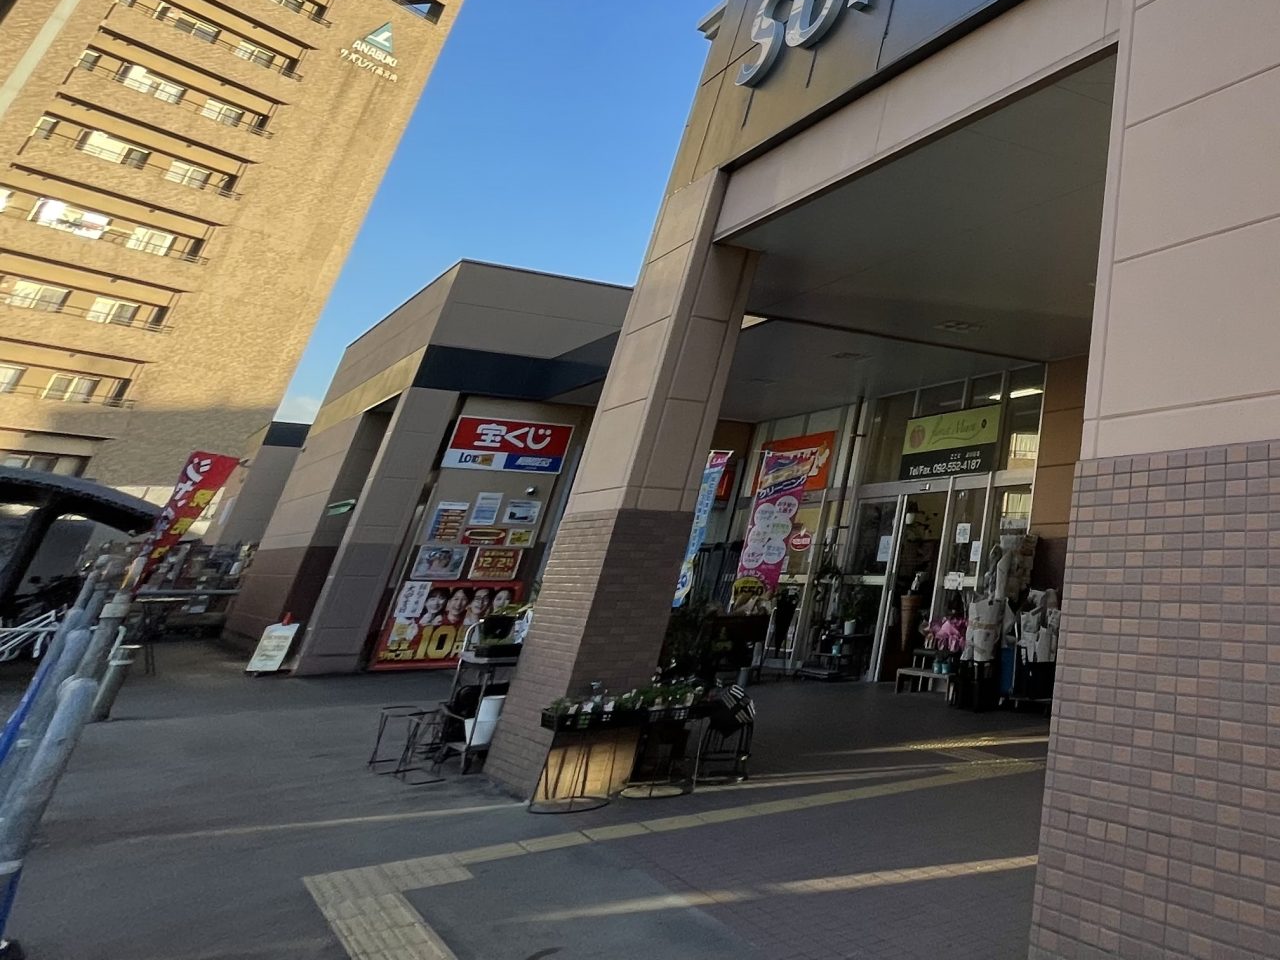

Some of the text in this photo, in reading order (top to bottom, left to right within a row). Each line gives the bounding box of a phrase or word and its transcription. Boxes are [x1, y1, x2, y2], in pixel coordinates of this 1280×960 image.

[352, 40, 398, 67] ANABUKI
[473, 423, 552, 450] 宝くじ
